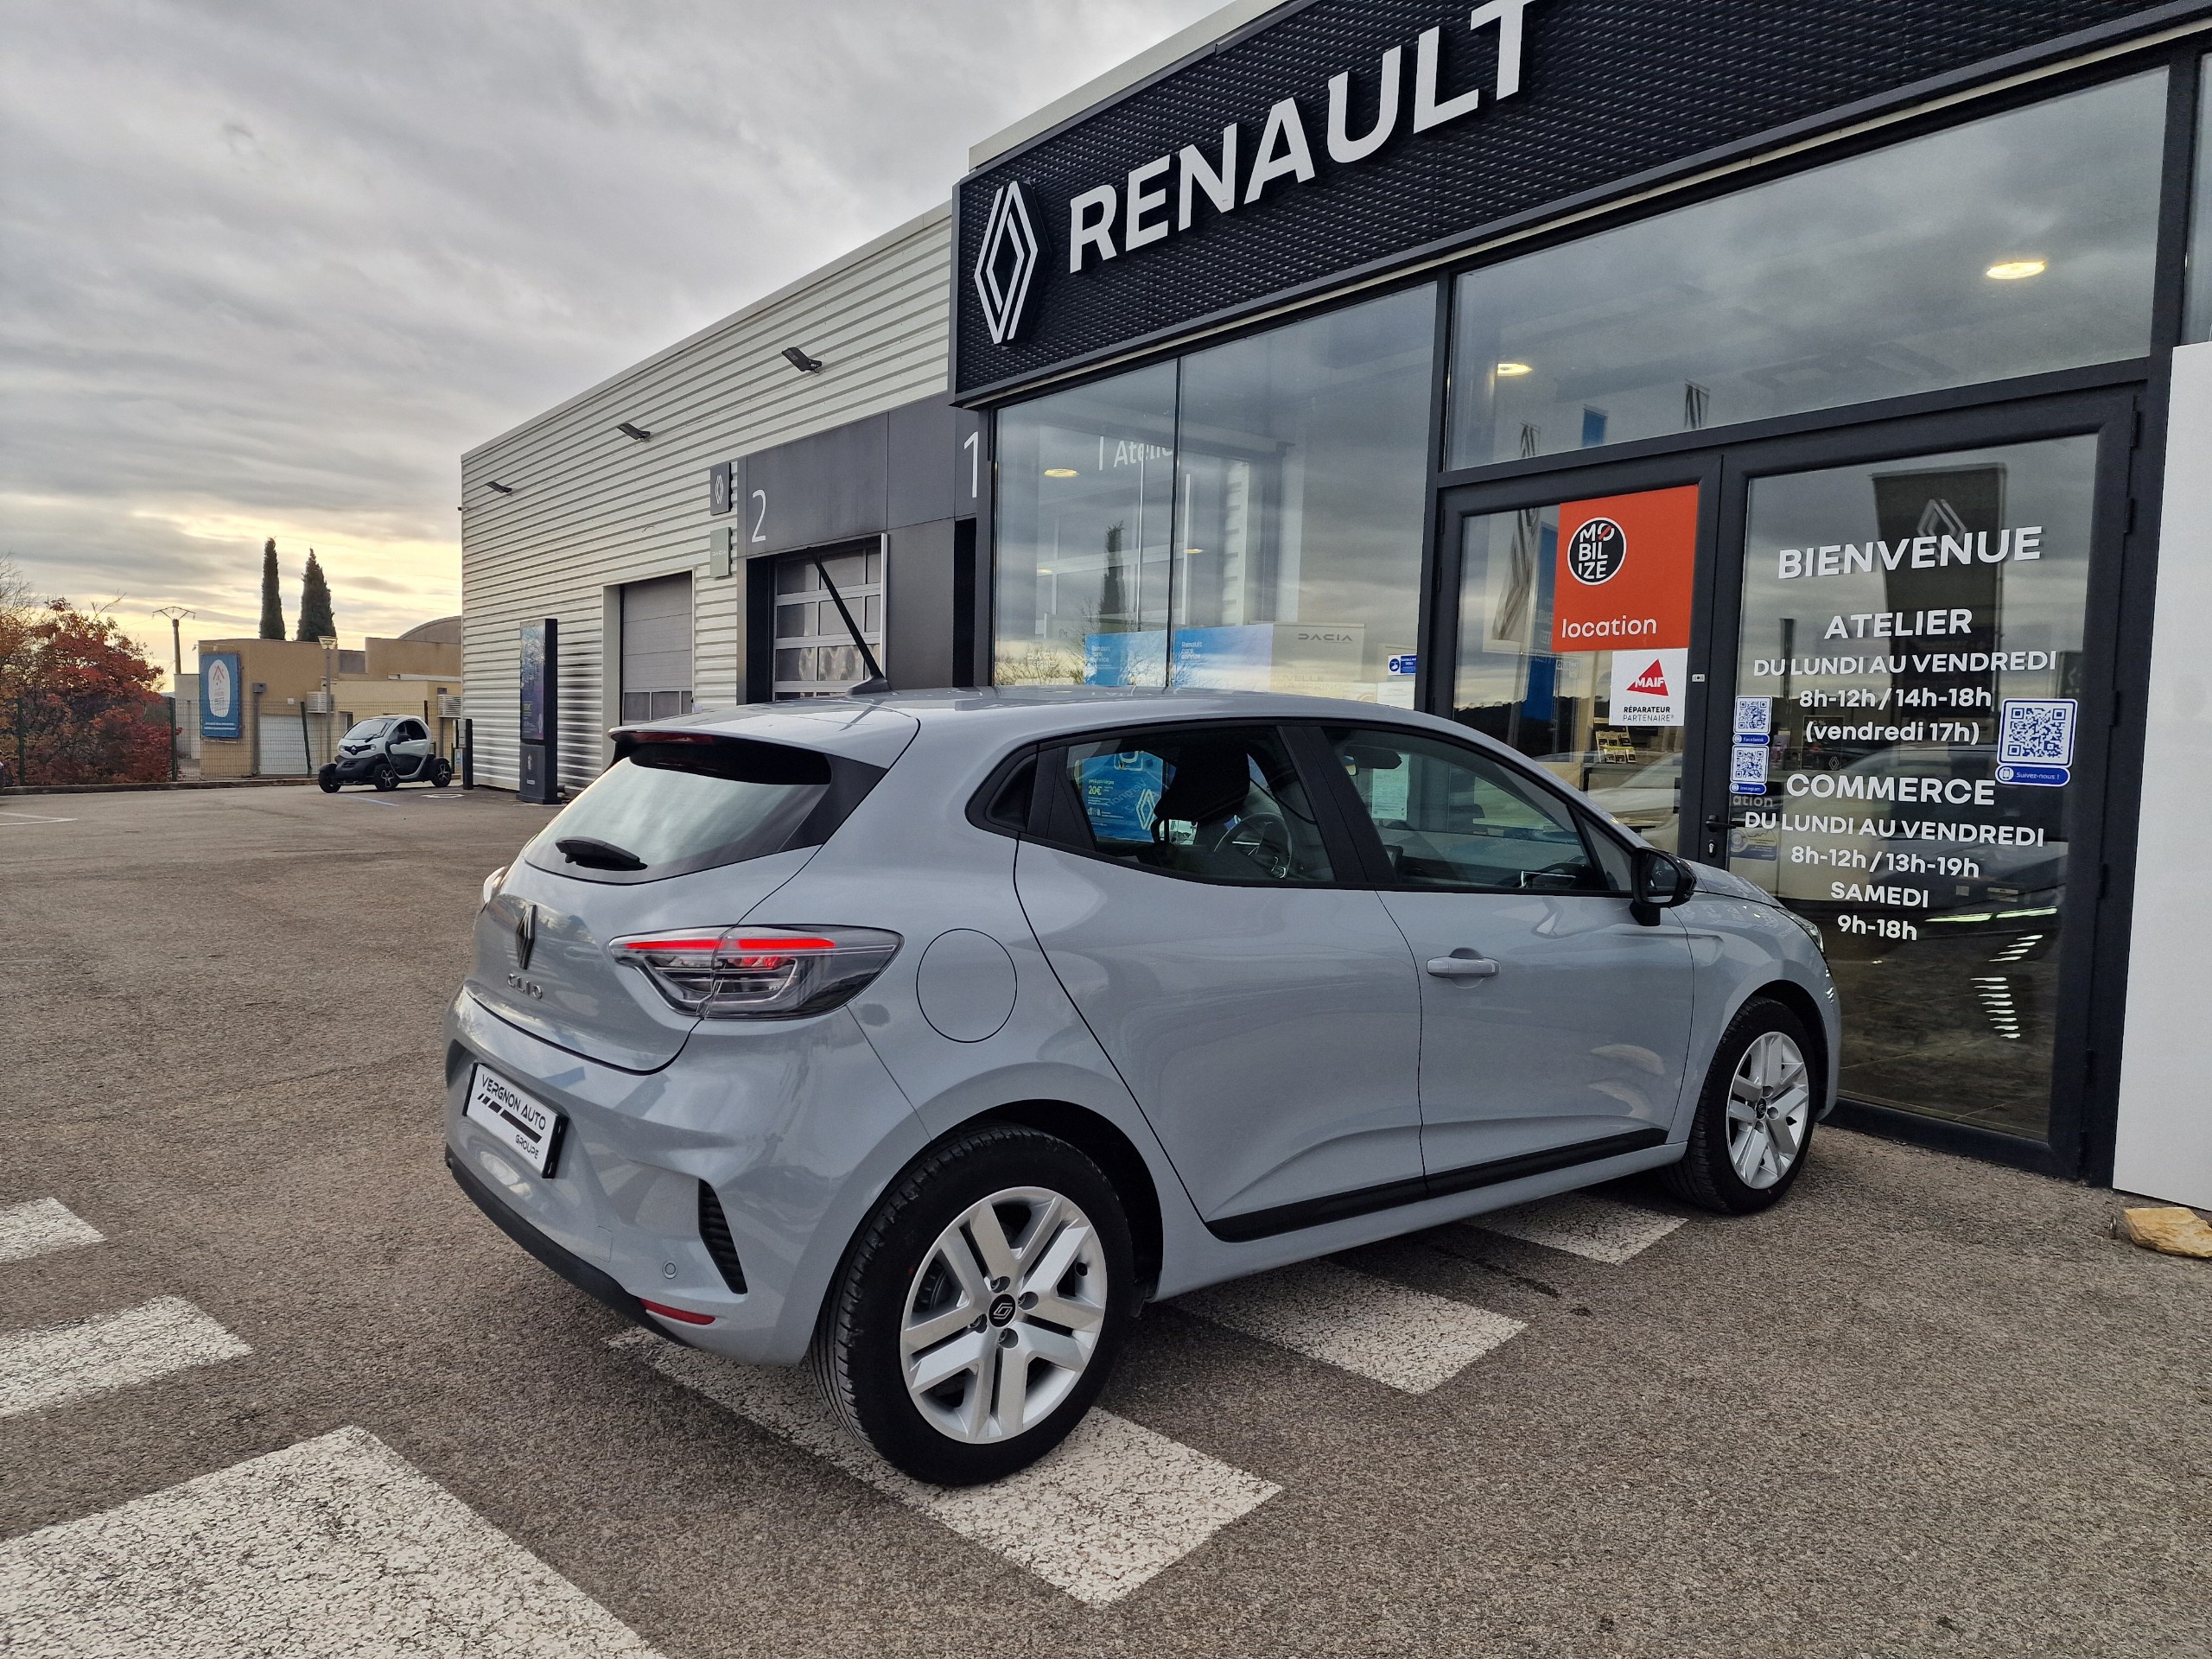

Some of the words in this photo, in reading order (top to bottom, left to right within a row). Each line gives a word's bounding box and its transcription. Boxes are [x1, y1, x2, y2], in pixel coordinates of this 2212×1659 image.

[1070, 0, 1534, 274] RENAULT
[963, 430, 979, 499] 1
[751, 488, 767, 543] 2
[1778, 525, 2043, 579] BIENVENUE
[1298, 632, 1353, 642] DACIA
[1561, 614, 1657, 639] location
[1824, 608, 1973, 639] ATELIER
[1753, 658, 1787, 677] DU
[1790, 656, 1864, 676] LUNDI
[1868, 655, 1906, 674] AU
[1913, 651, 2056, 672] VENDREDI
[1634, 677, 1666, 689] MAIF
[1623, 704, 1671, 714] RÉPARATEUR
[1799, 688, 1877, 708] 8h-12h
[1896, 686, 1993, 708] 14h-18h
[1805, 721, 1924, 744] (vendredi
[1928, 721, 1980, 745] 17h)
[1786, 773, 1997, 805] COMMERCE
[2016, 772, 2056, 780] Suivez-nous
[1745, 811, 1777, 830] DU
[1782, 813, 1854, 835] LUNDI
[1858, 818, 1896, 837] AU
[1901, 820, 2044, 848] VENDREDI
[1790, 845, 1866, 868] 8h-12h
[1886, 852, 1980, 878] 13h-19h
[1830, 881, 1929, 908] SAMEDI
[1837, 914, 1917, 941] 9h-18h
[507, 972, 543, 1000] CLIO
[481, 1073, 522, 1113] VERGNON
[520, 1103, 547, 1131] AUTO
[515, 1134, 540, 1160] GROUPE
